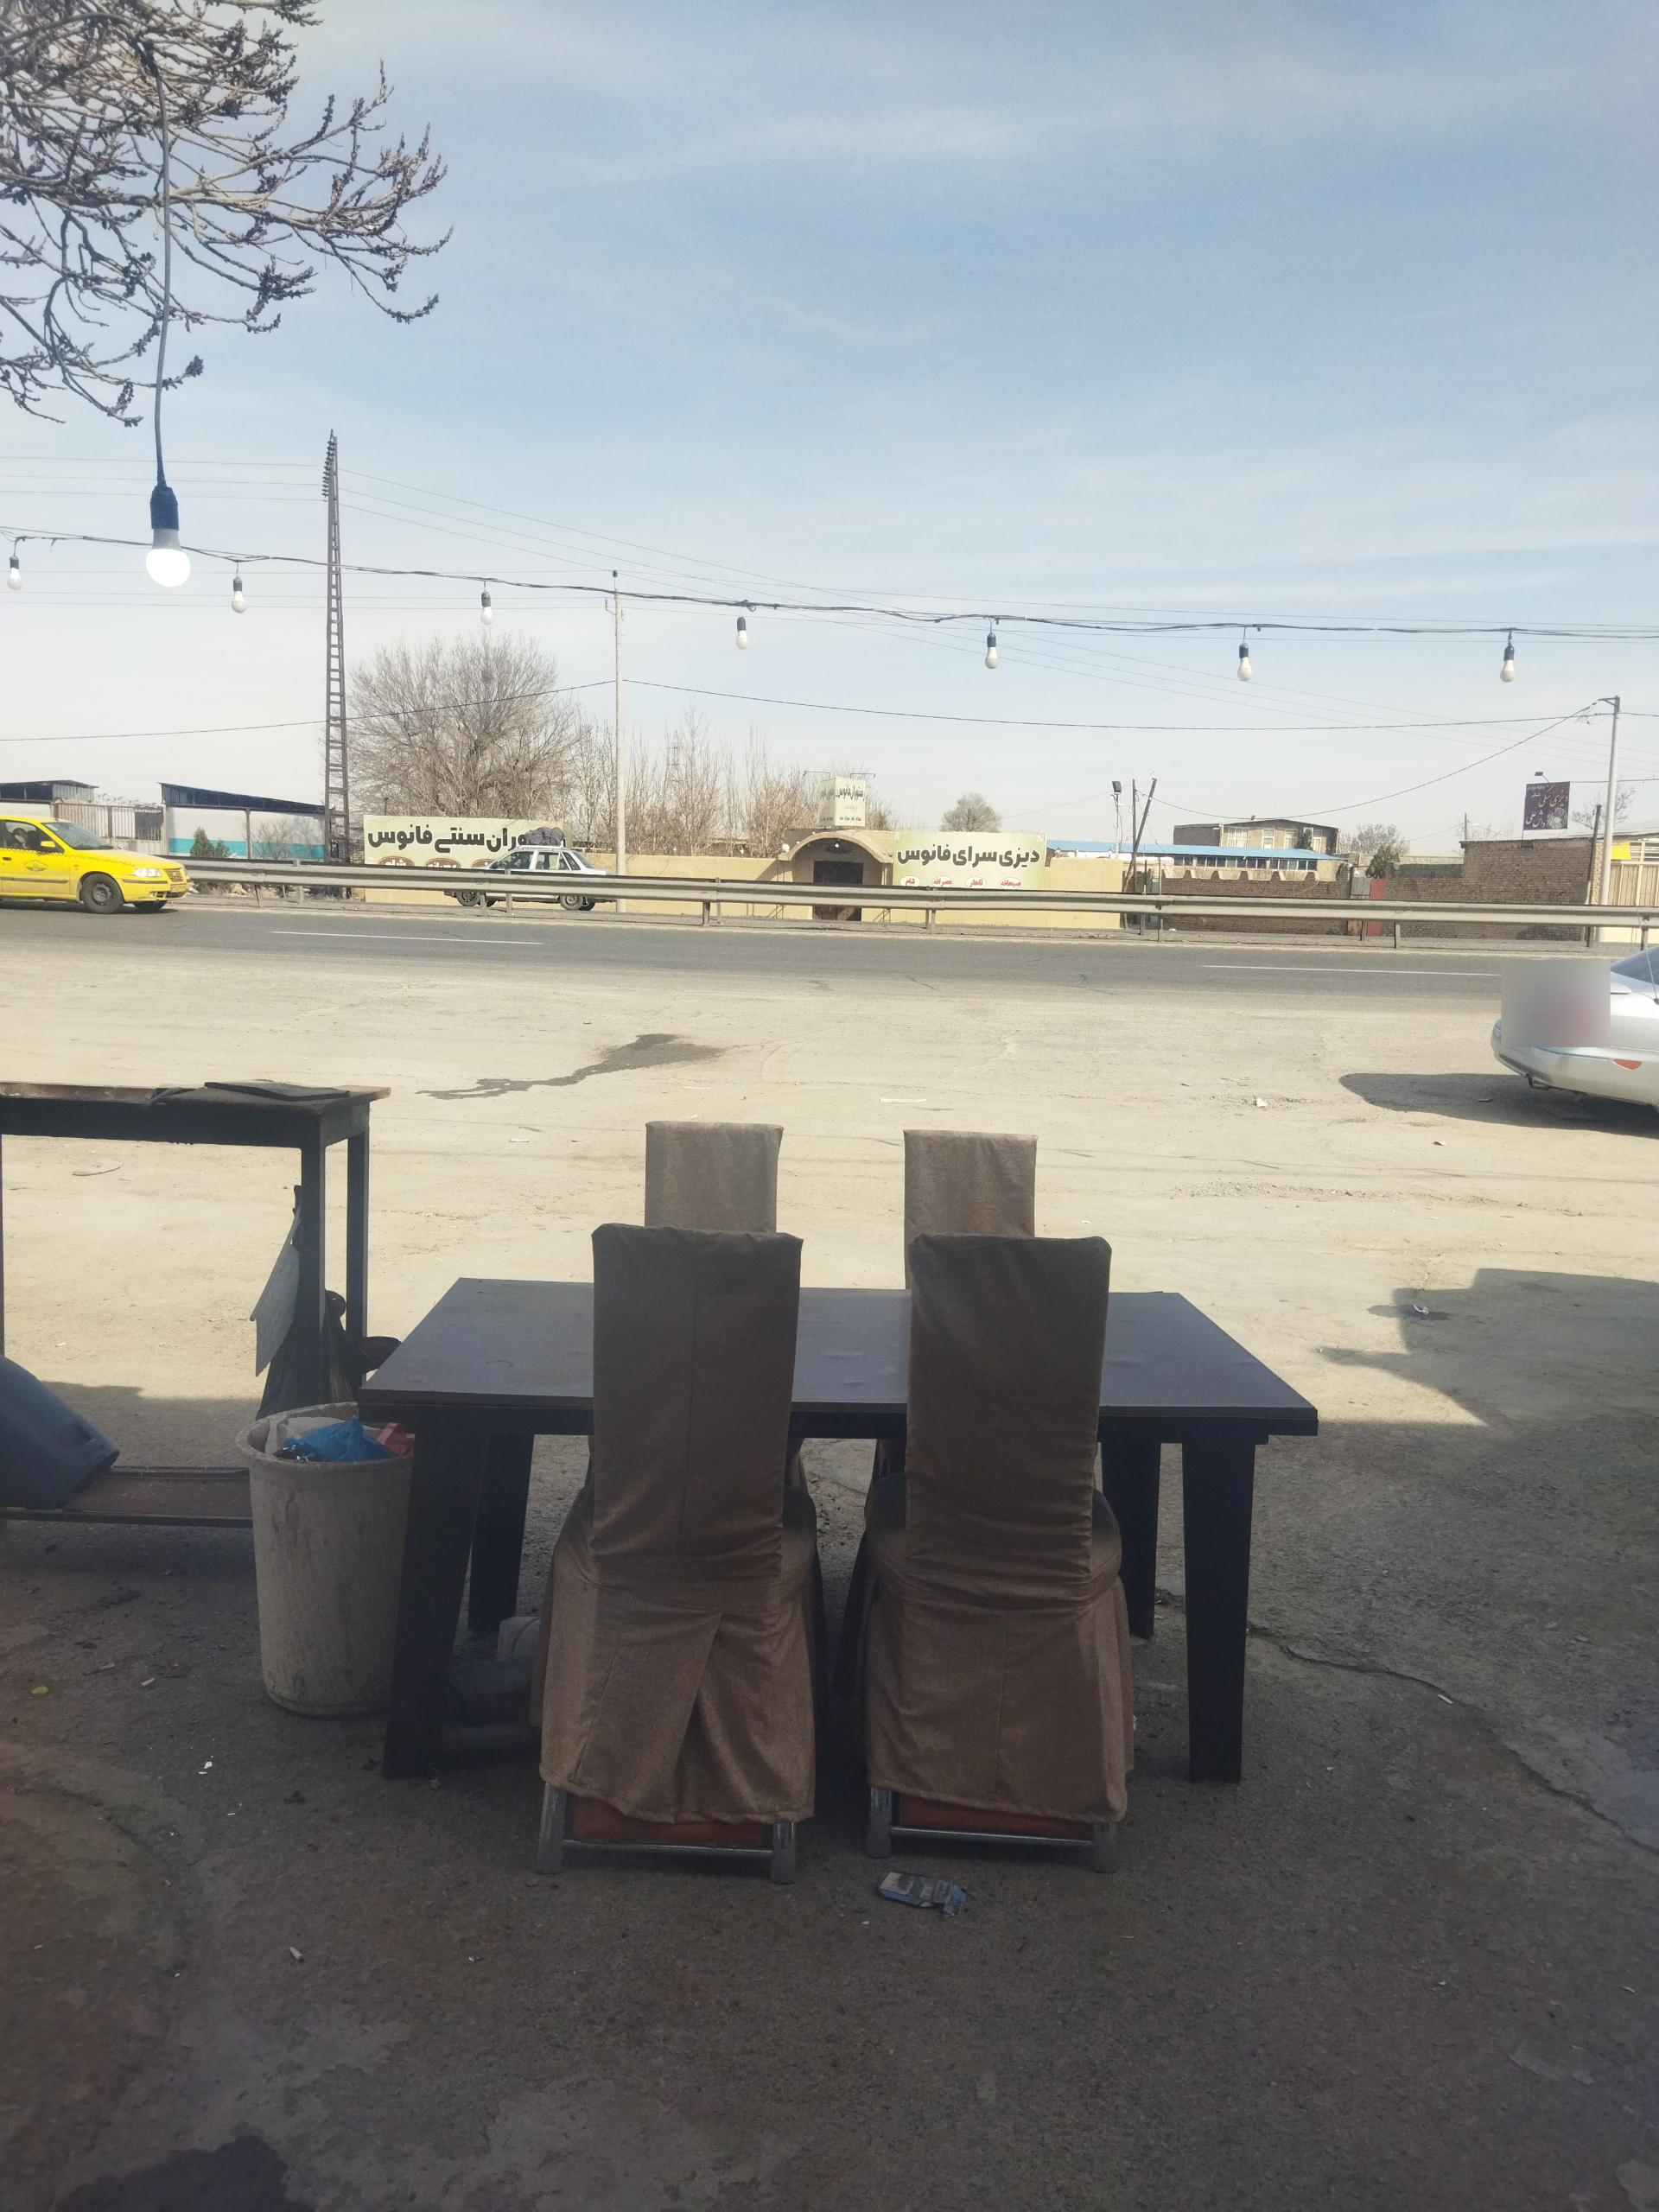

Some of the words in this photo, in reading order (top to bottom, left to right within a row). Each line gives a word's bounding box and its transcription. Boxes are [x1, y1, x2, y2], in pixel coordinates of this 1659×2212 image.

[367, 823, 433, 851] فانوس
[434, 826, 485, 854] سنتی
[897, 843, 951, 867] فانوس
[952, 845, 998, 868] سرای
[998, 847, 1040, 869] دیزی
